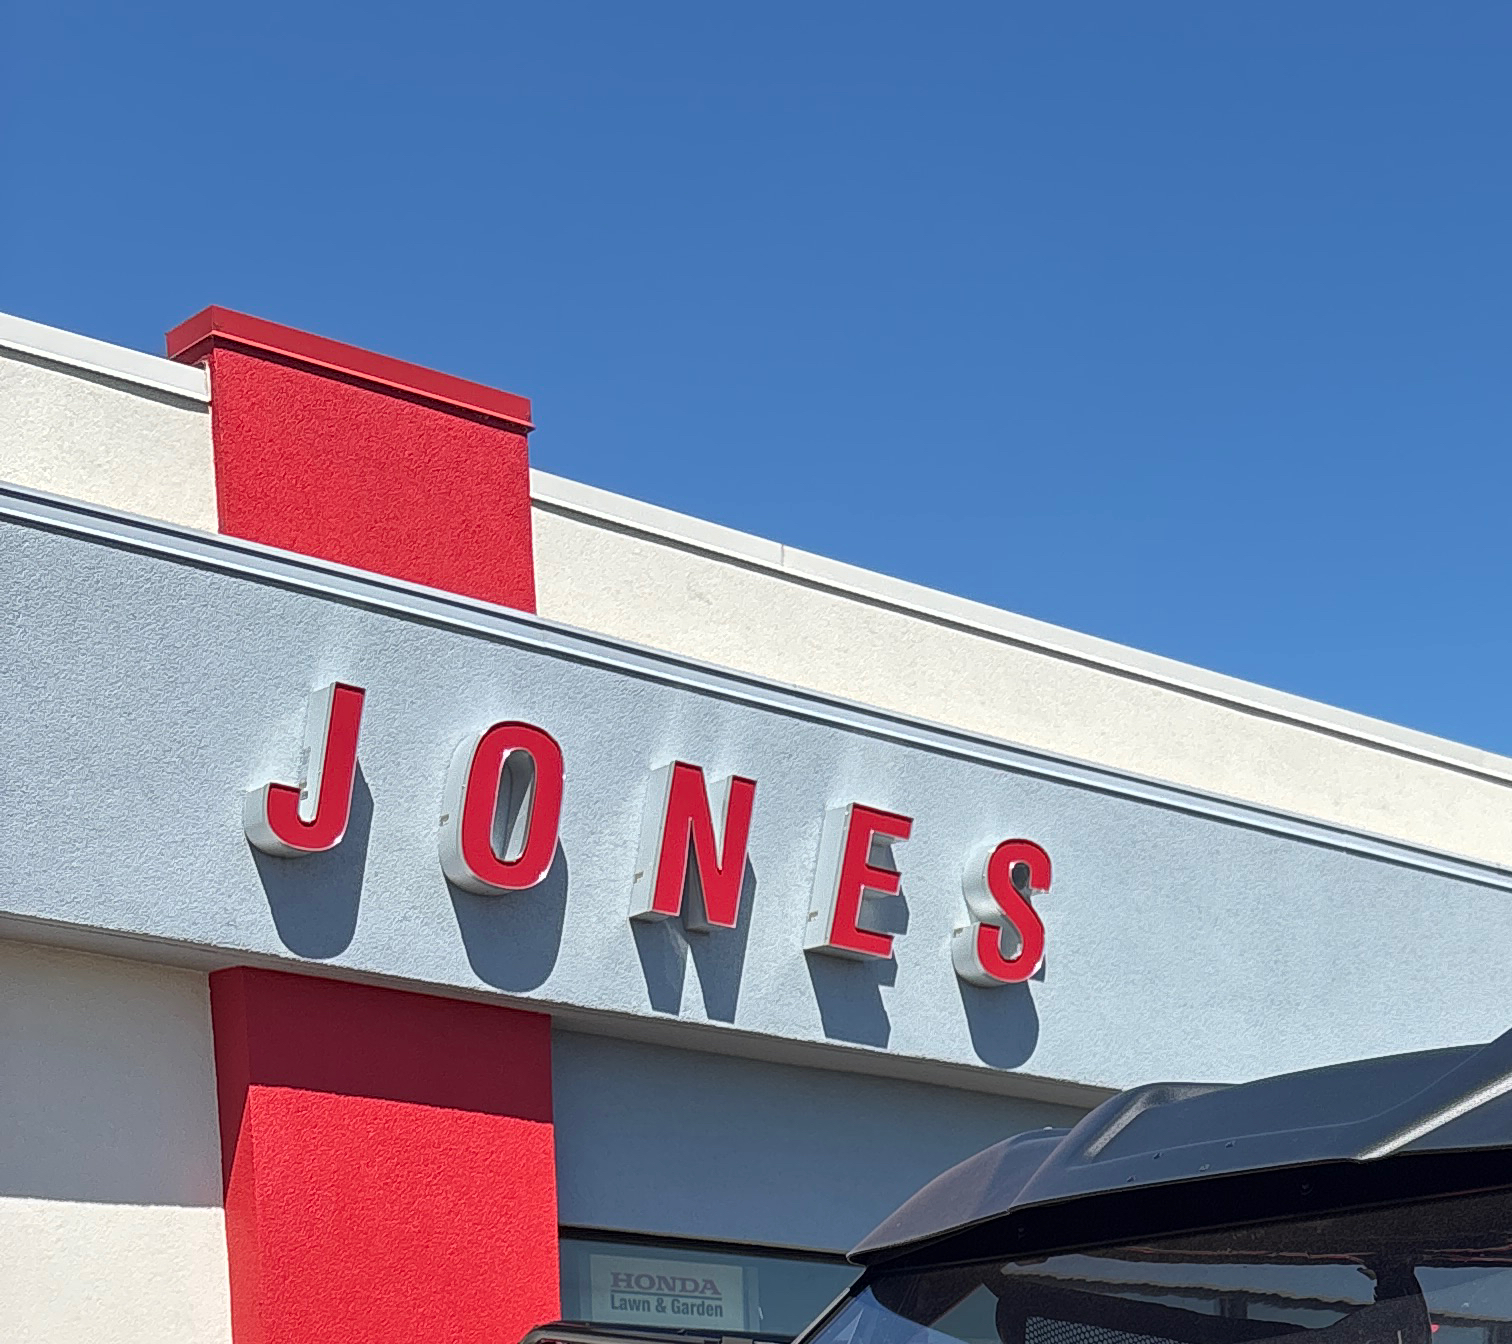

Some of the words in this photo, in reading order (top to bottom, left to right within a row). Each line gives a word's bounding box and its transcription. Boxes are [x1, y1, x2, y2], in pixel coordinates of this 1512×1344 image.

[258, 682, 1053, 985] JONES
[611, 1272, 721, 1295] HONDA
[610, 1294, 650, 1313] Lawn
[655, 1296, 667, 1314] &
[671, 1298, 723, 1317] Garden
